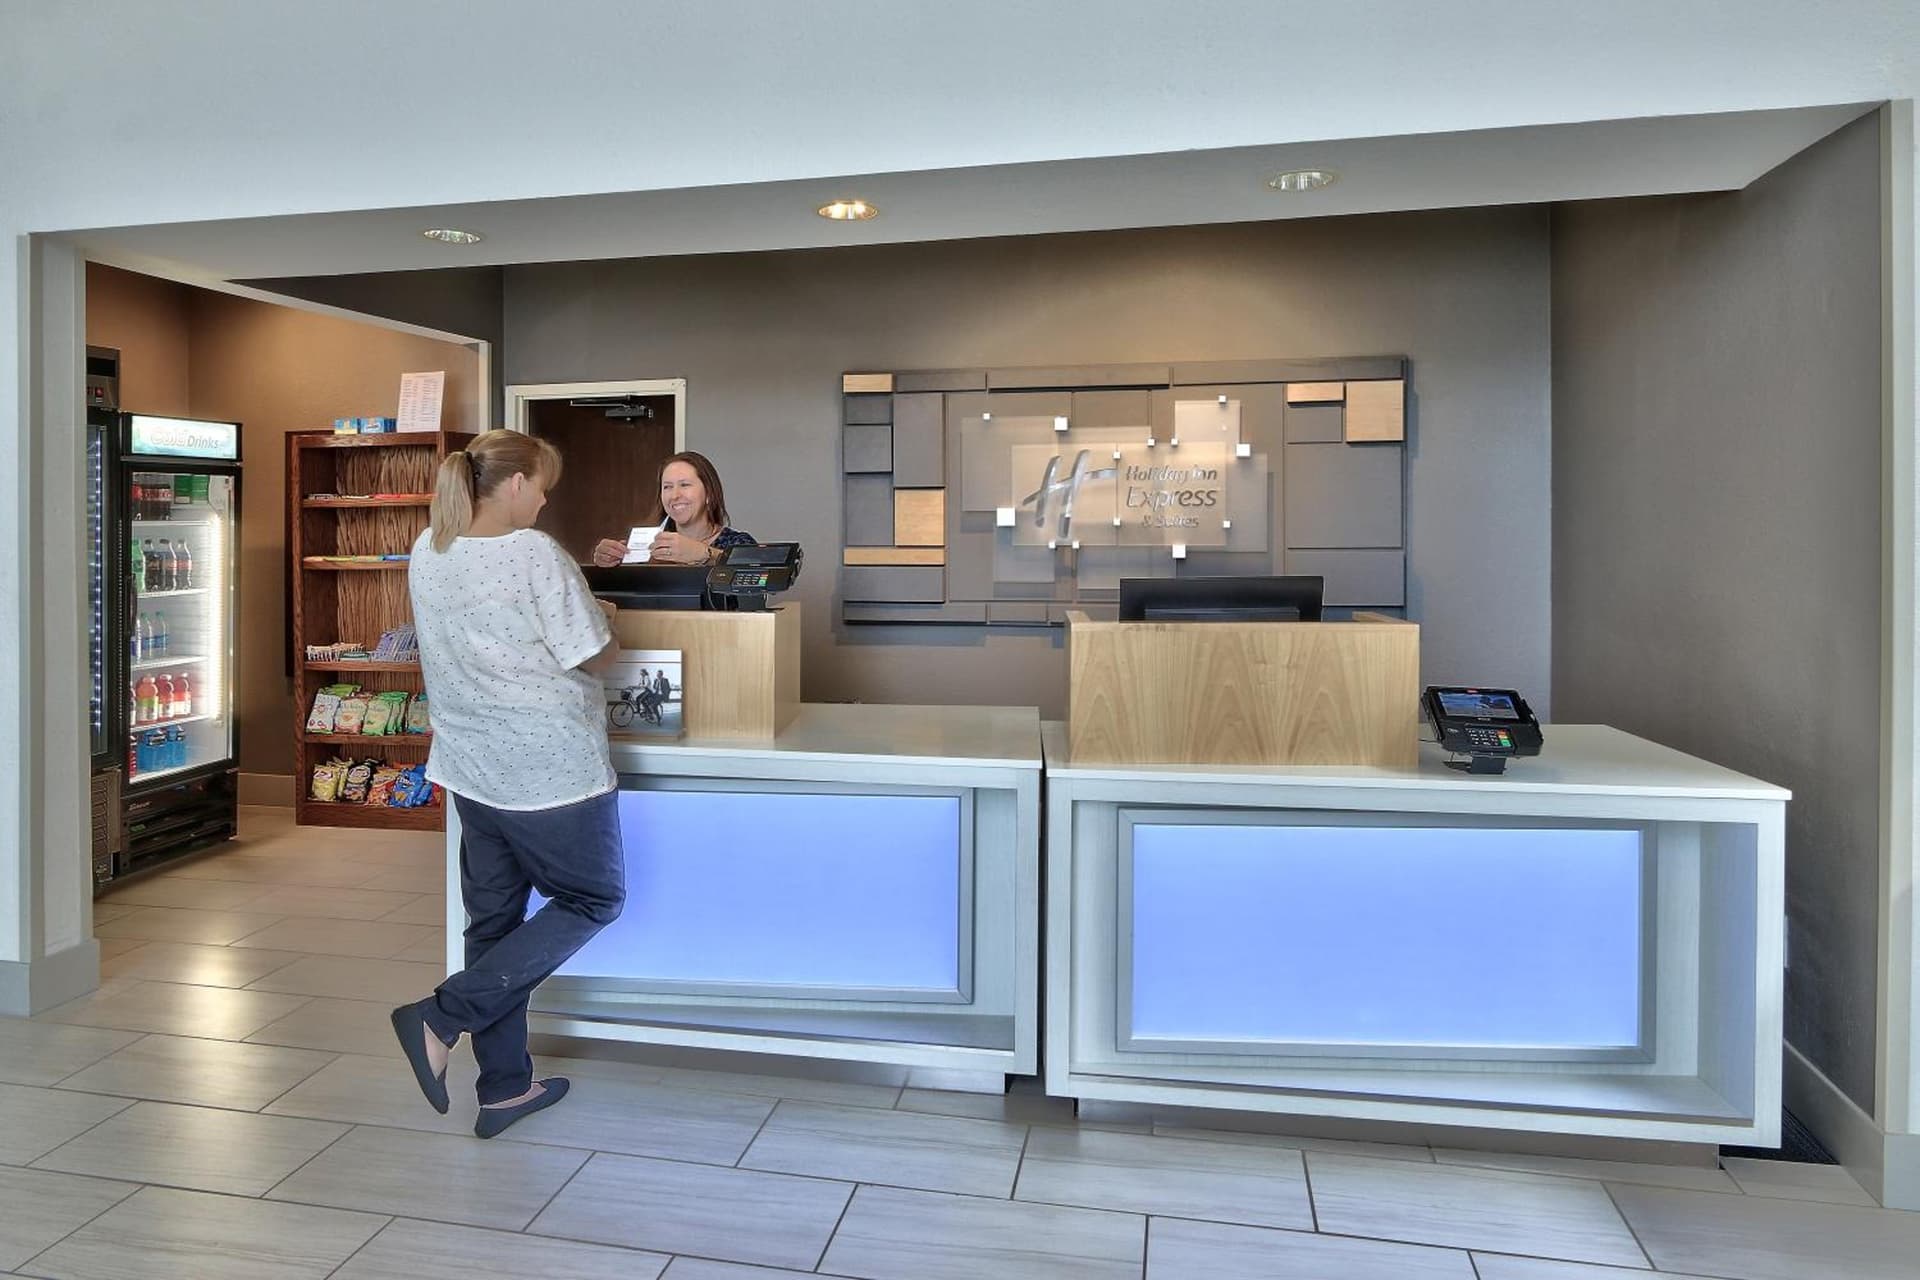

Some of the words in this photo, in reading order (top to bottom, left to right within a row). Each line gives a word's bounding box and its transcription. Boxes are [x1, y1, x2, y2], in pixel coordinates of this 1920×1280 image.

[186, 434, 219, 449] Drinks
[1126, 465, 1189, 484] Holiday
[1192, 464, 1217, 480] Inn
[1126, 486, 1218, 511] Express
[1142, 515, 1152, 528] &
[1156, 515, 1200, 528] Suites
